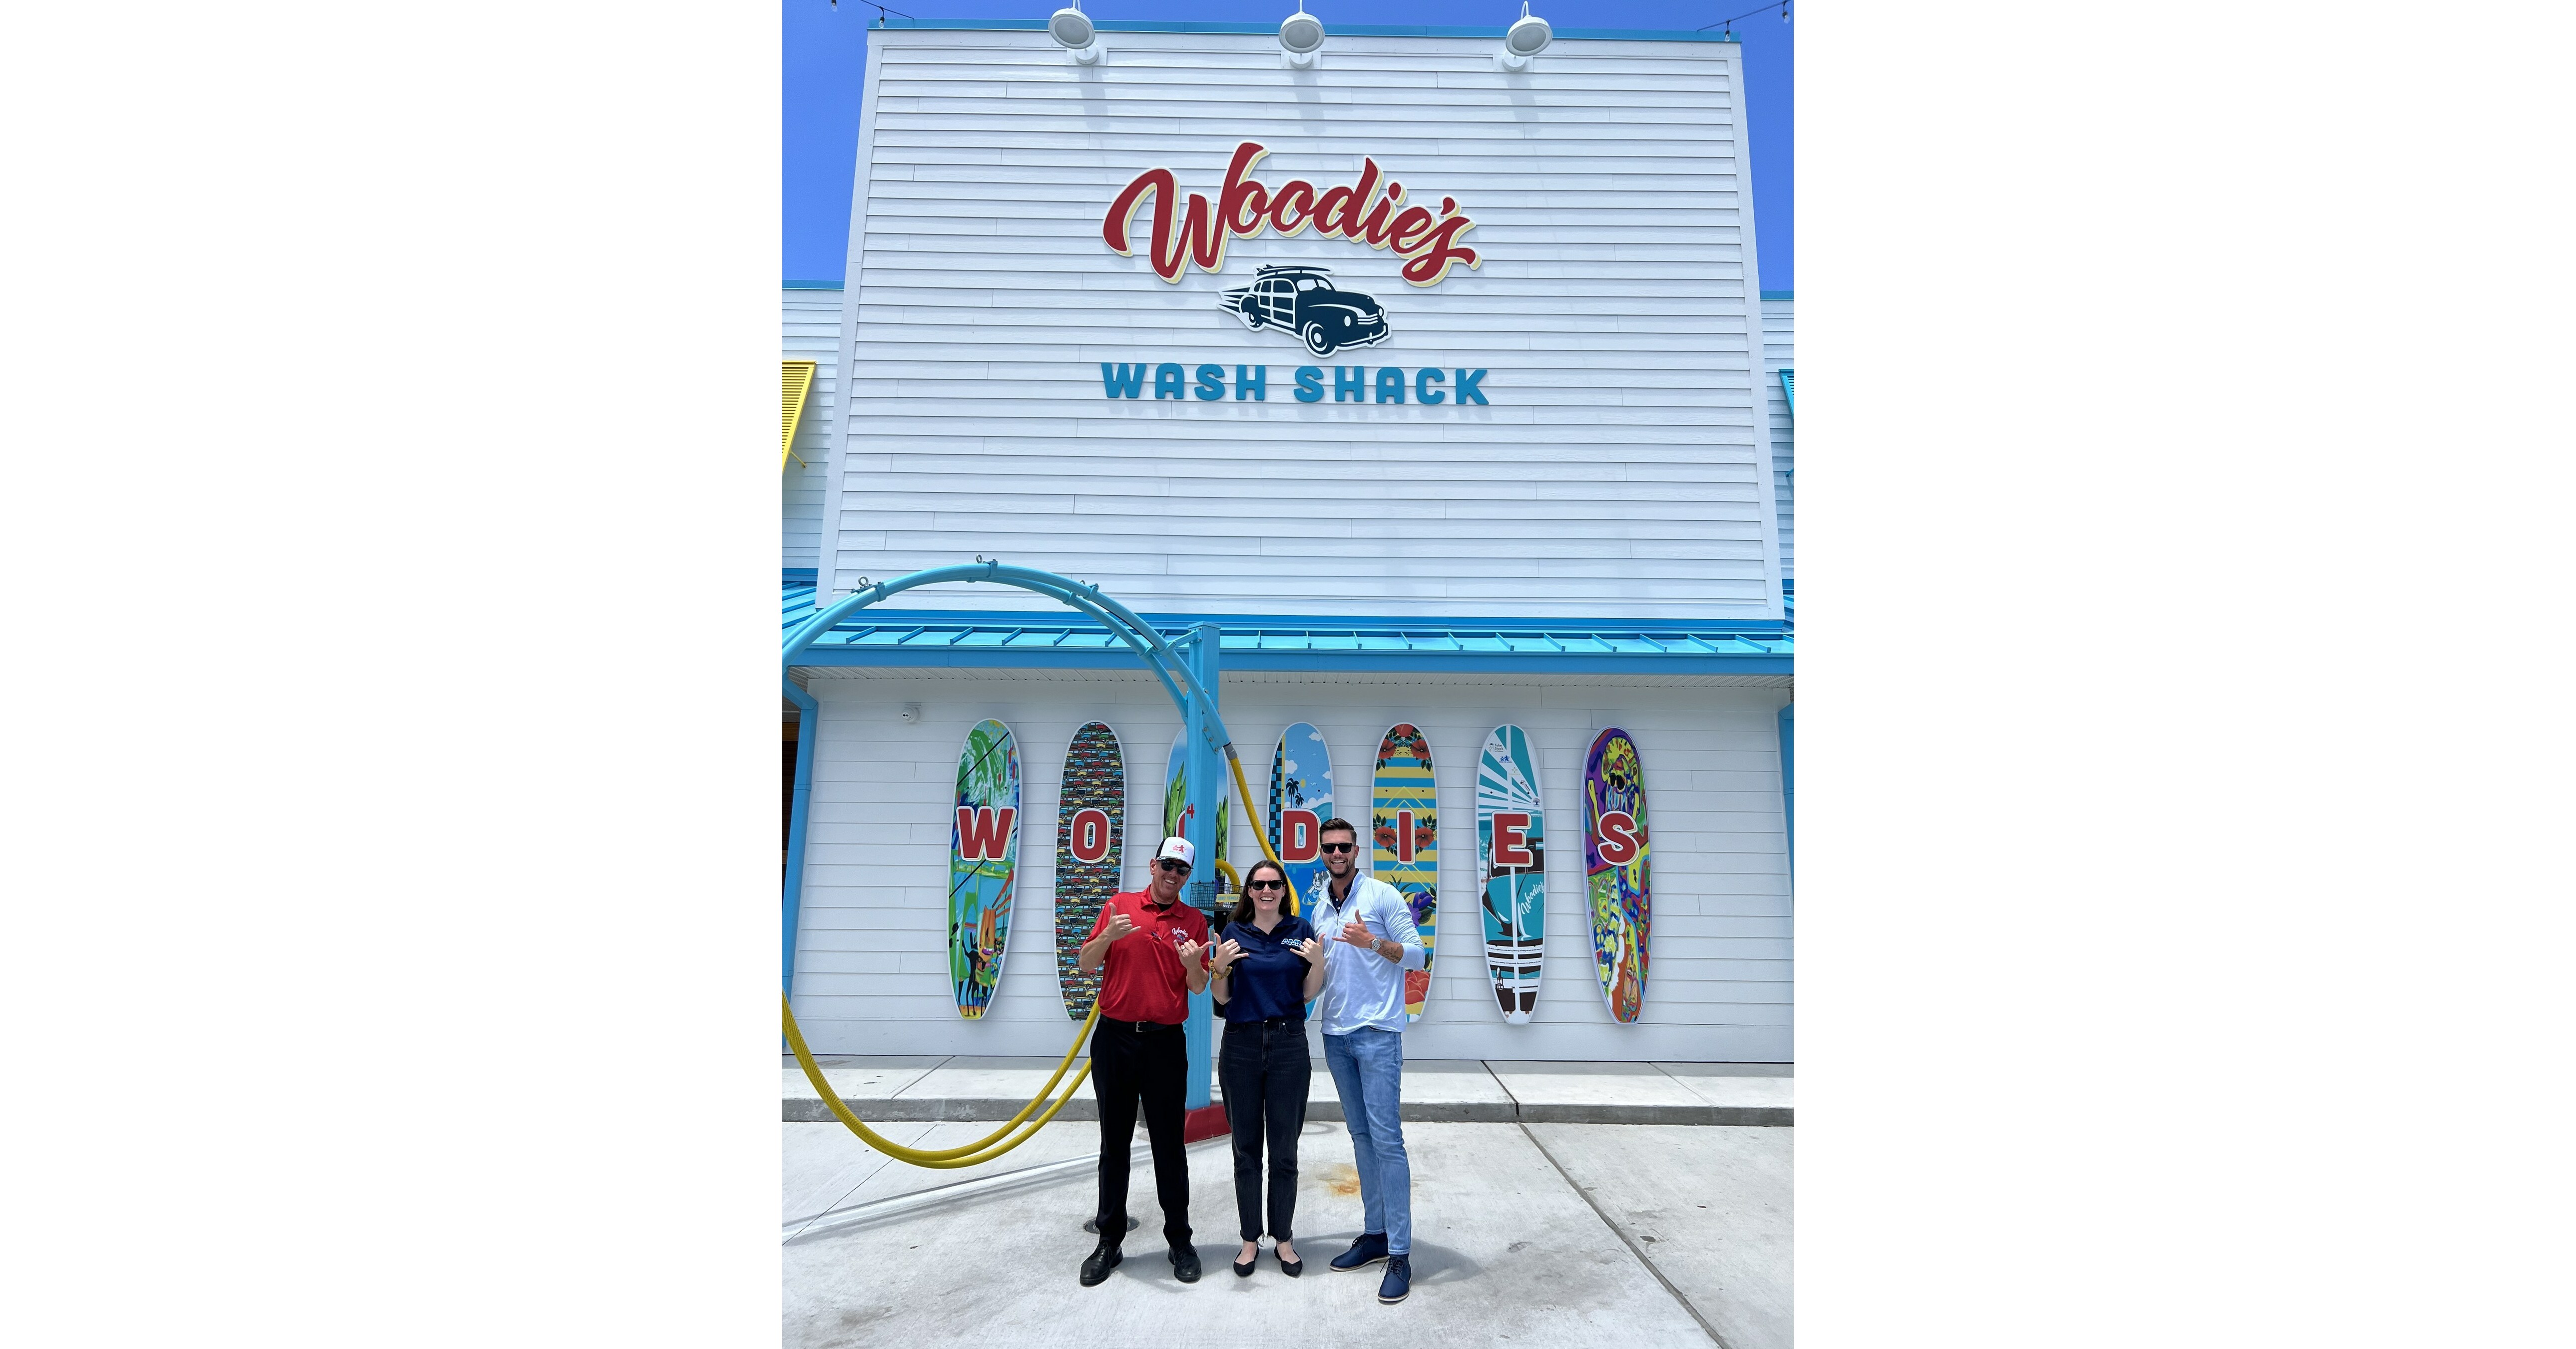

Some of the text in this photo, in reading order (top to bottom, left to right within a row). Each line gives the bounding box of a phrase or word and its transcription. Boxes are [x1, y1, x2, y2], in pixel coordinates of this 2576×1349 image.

[1102, 140, 1482, 288] Woodie's
[1101, 362, 1489, 405] WASH SHACK
[1186, 803, 1194, 819] 4
[1521, 881, 1545, 915] Woodie's
